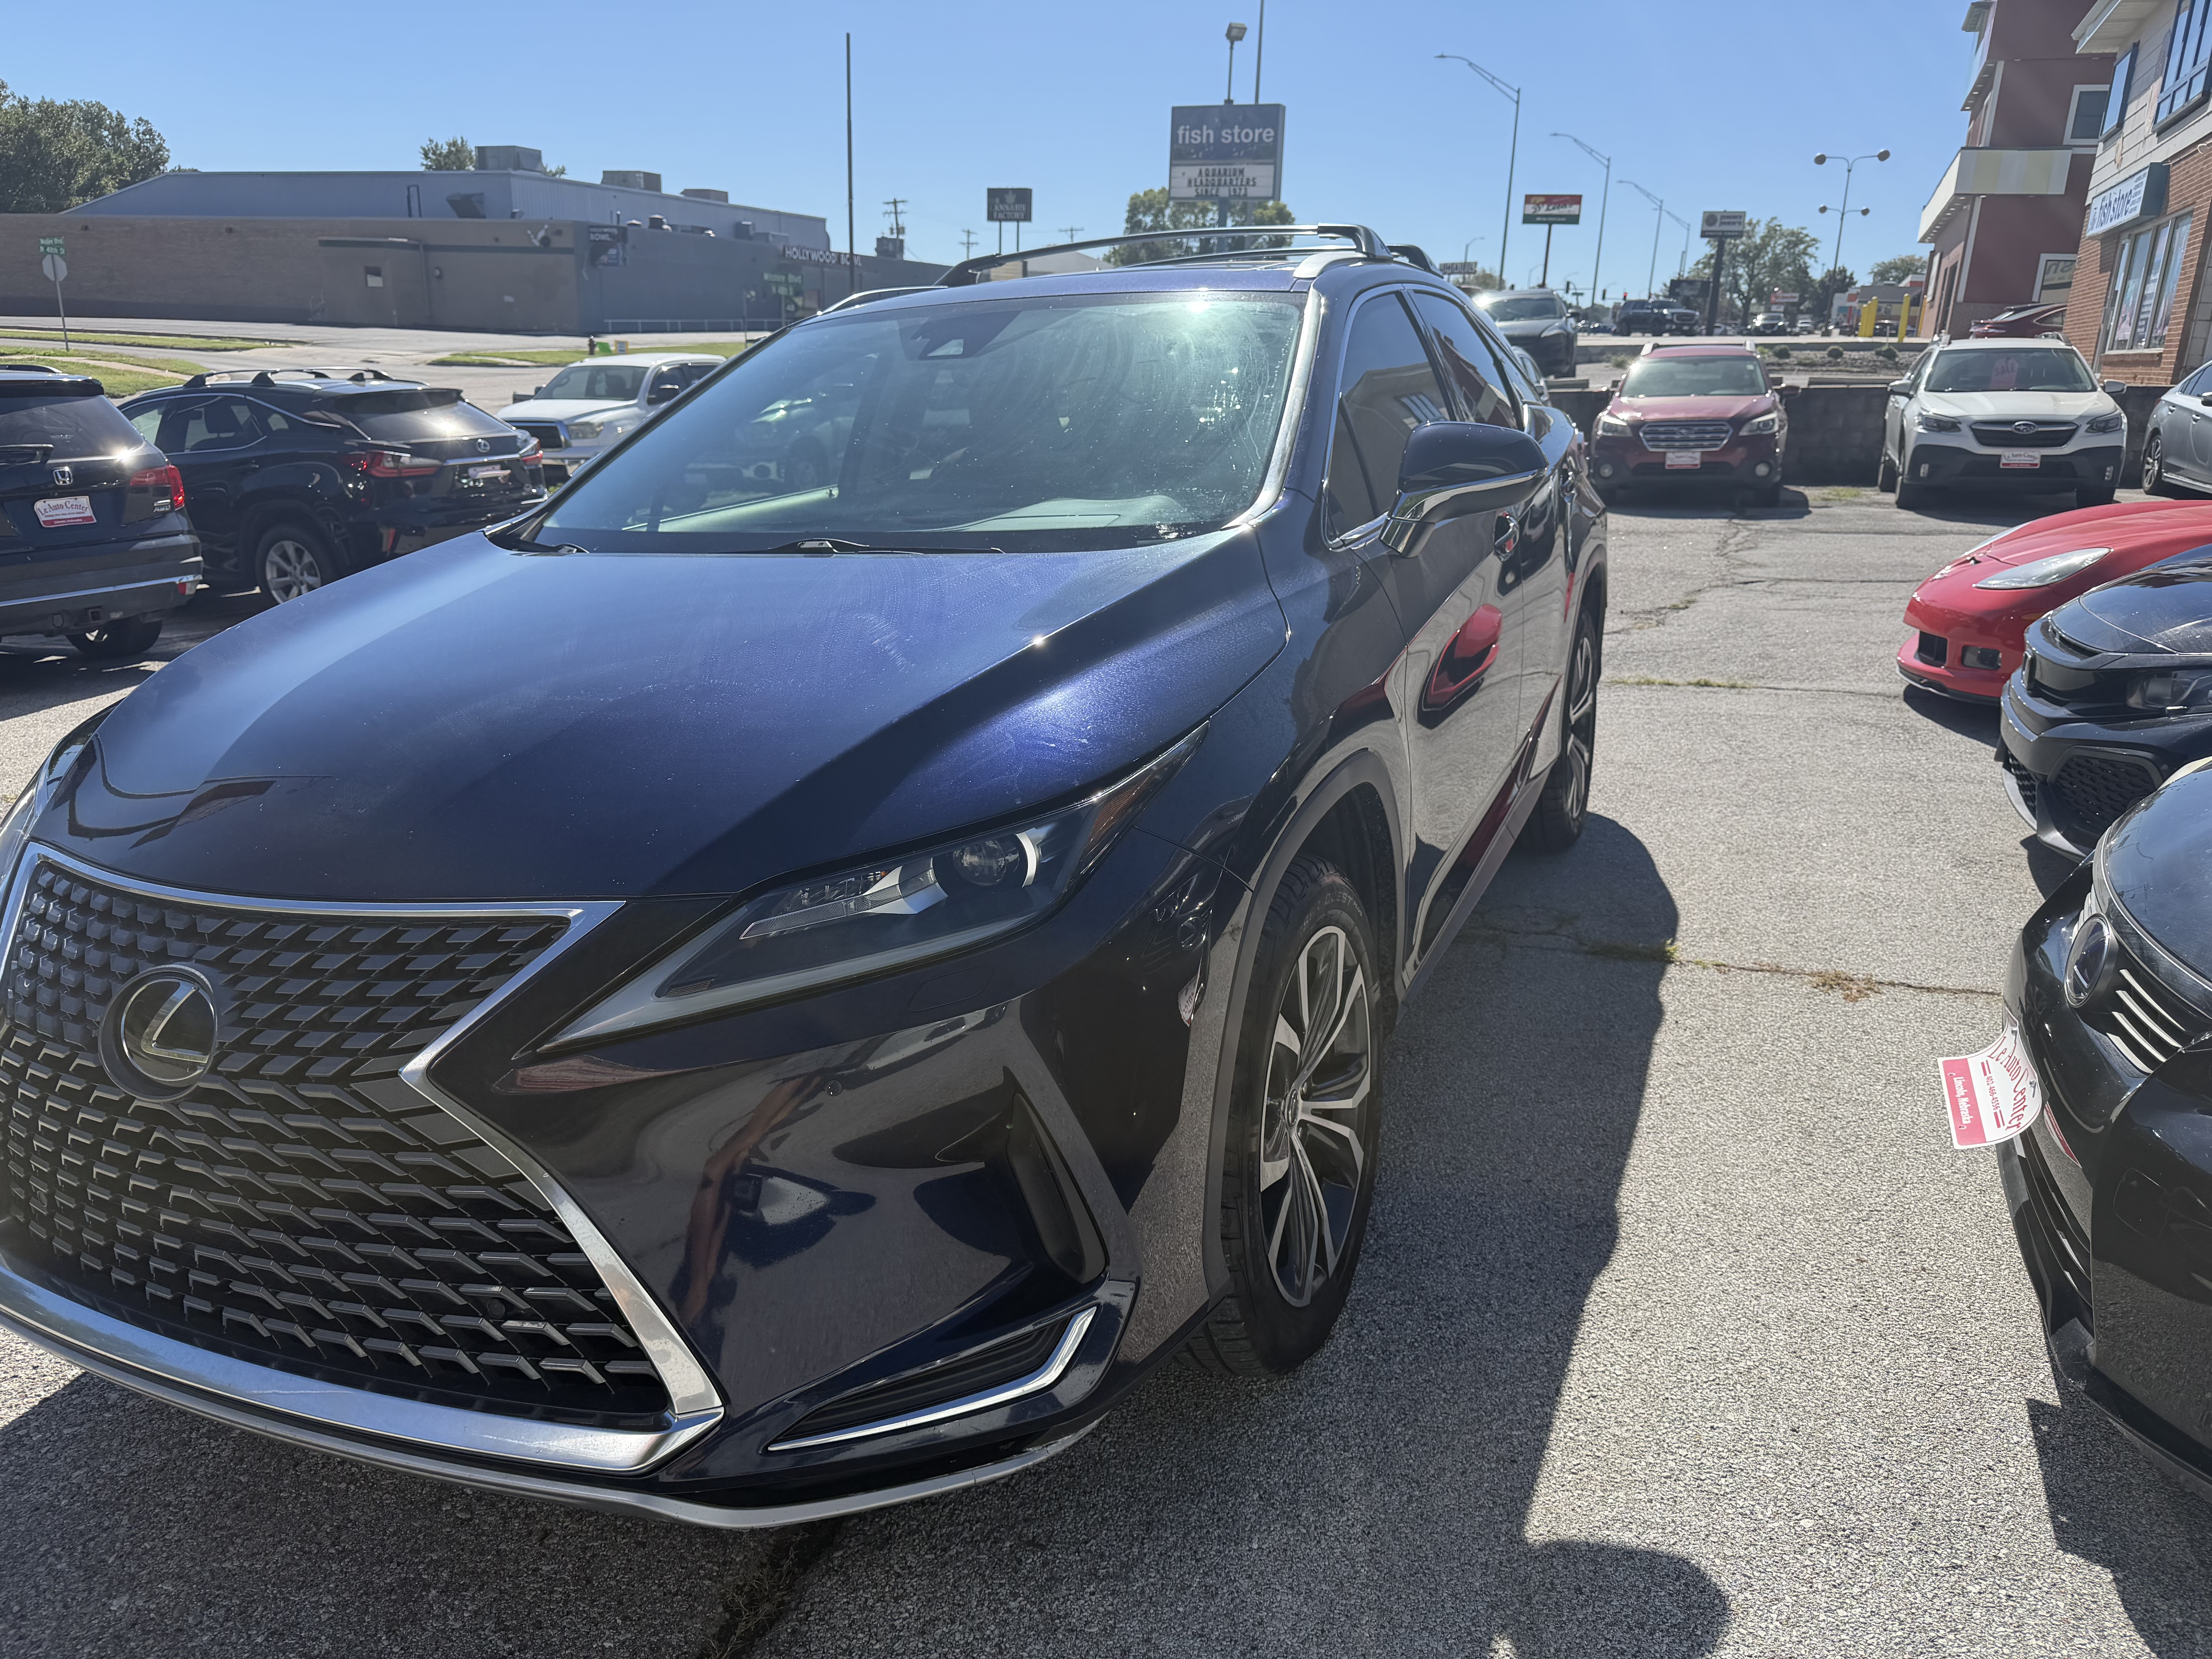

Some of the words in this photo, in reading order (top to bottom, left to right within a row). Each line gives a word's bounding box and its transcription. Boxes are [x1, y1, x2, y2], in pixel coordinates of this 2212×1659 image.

[1177, 125, 1214, 144] fish
[1221, 125, 1275, 144] store
[1187, 177, 1257, 187] HEADQUARTERS
[1197, 167, 1245, 177] AQUARIUM
[1194, 188, 1219, 197] SINCE
[2095, 192, 2112, 229] fish
[2110, 189, 2133, 223] store
[784, 246, 837, 263] HOLLYWOOD
[38, 507, 48, 515] Le
[48, 503, 64, 512] Auto
[65, 500, 89, 512] Center
[1987, 1036, 2007, 1061] Le
[2000, 1042, 2021, 1081] Auto
[1953, 1077, 1968, 1097] Lincoln,
[1985, 1076, 2000, 1110] 402-466-4556
[2005, 1067, 2029, 1131] Center
[1958, 1097, 1973, 1124] Nebraska
